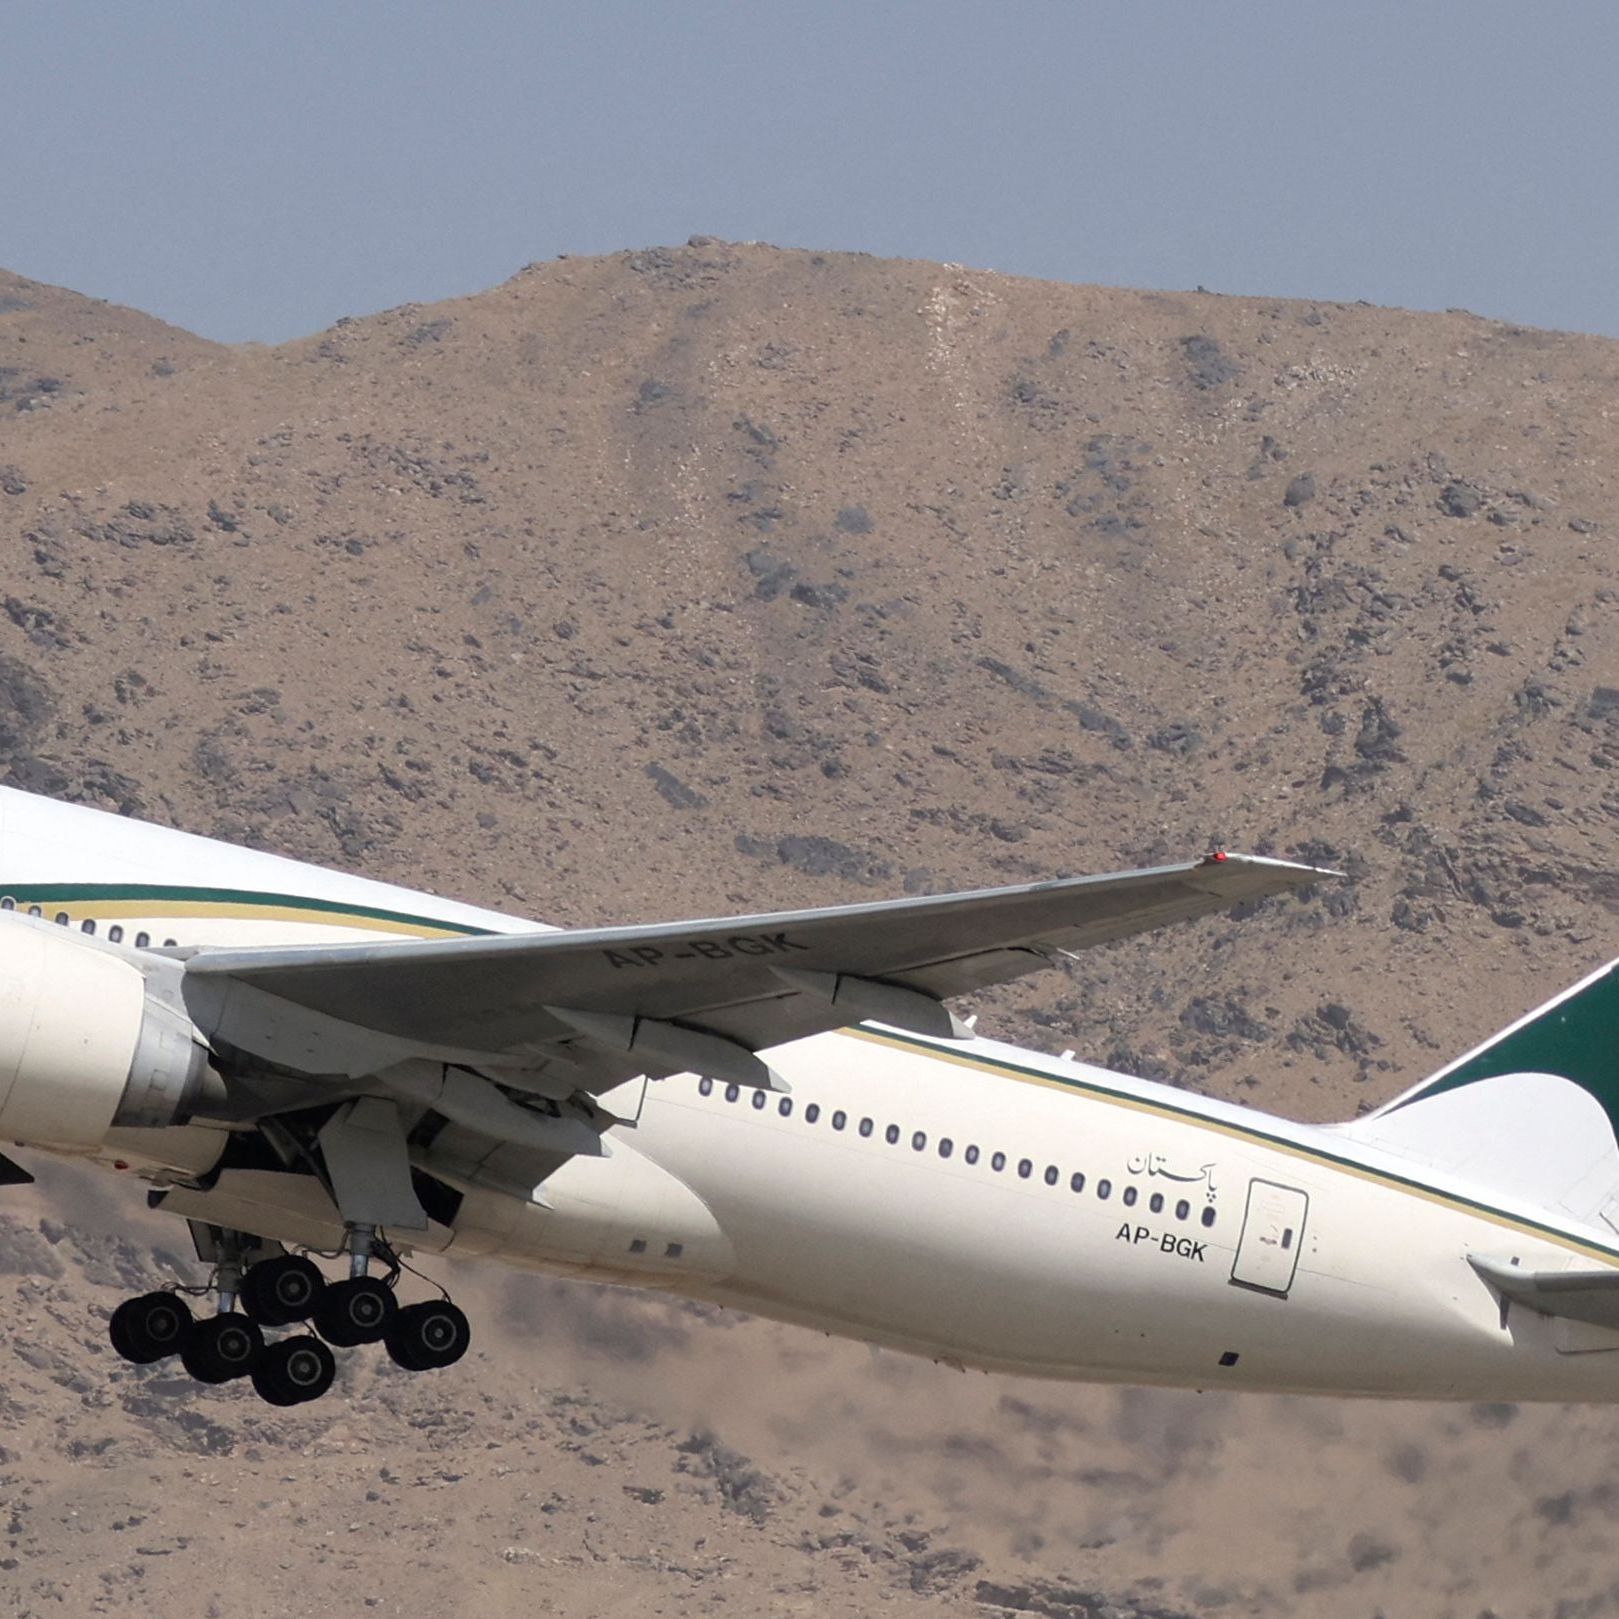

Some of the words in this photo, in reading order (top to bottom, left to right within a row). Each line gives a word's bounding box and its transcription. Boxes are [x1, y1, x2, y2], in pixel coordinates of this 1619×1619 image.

[601, 932, 809, 969] AP-BGK
[1126, 1152, 1218, 1204] پاکستان
[1115, 1222, 1208, 1263] AP-BGK
